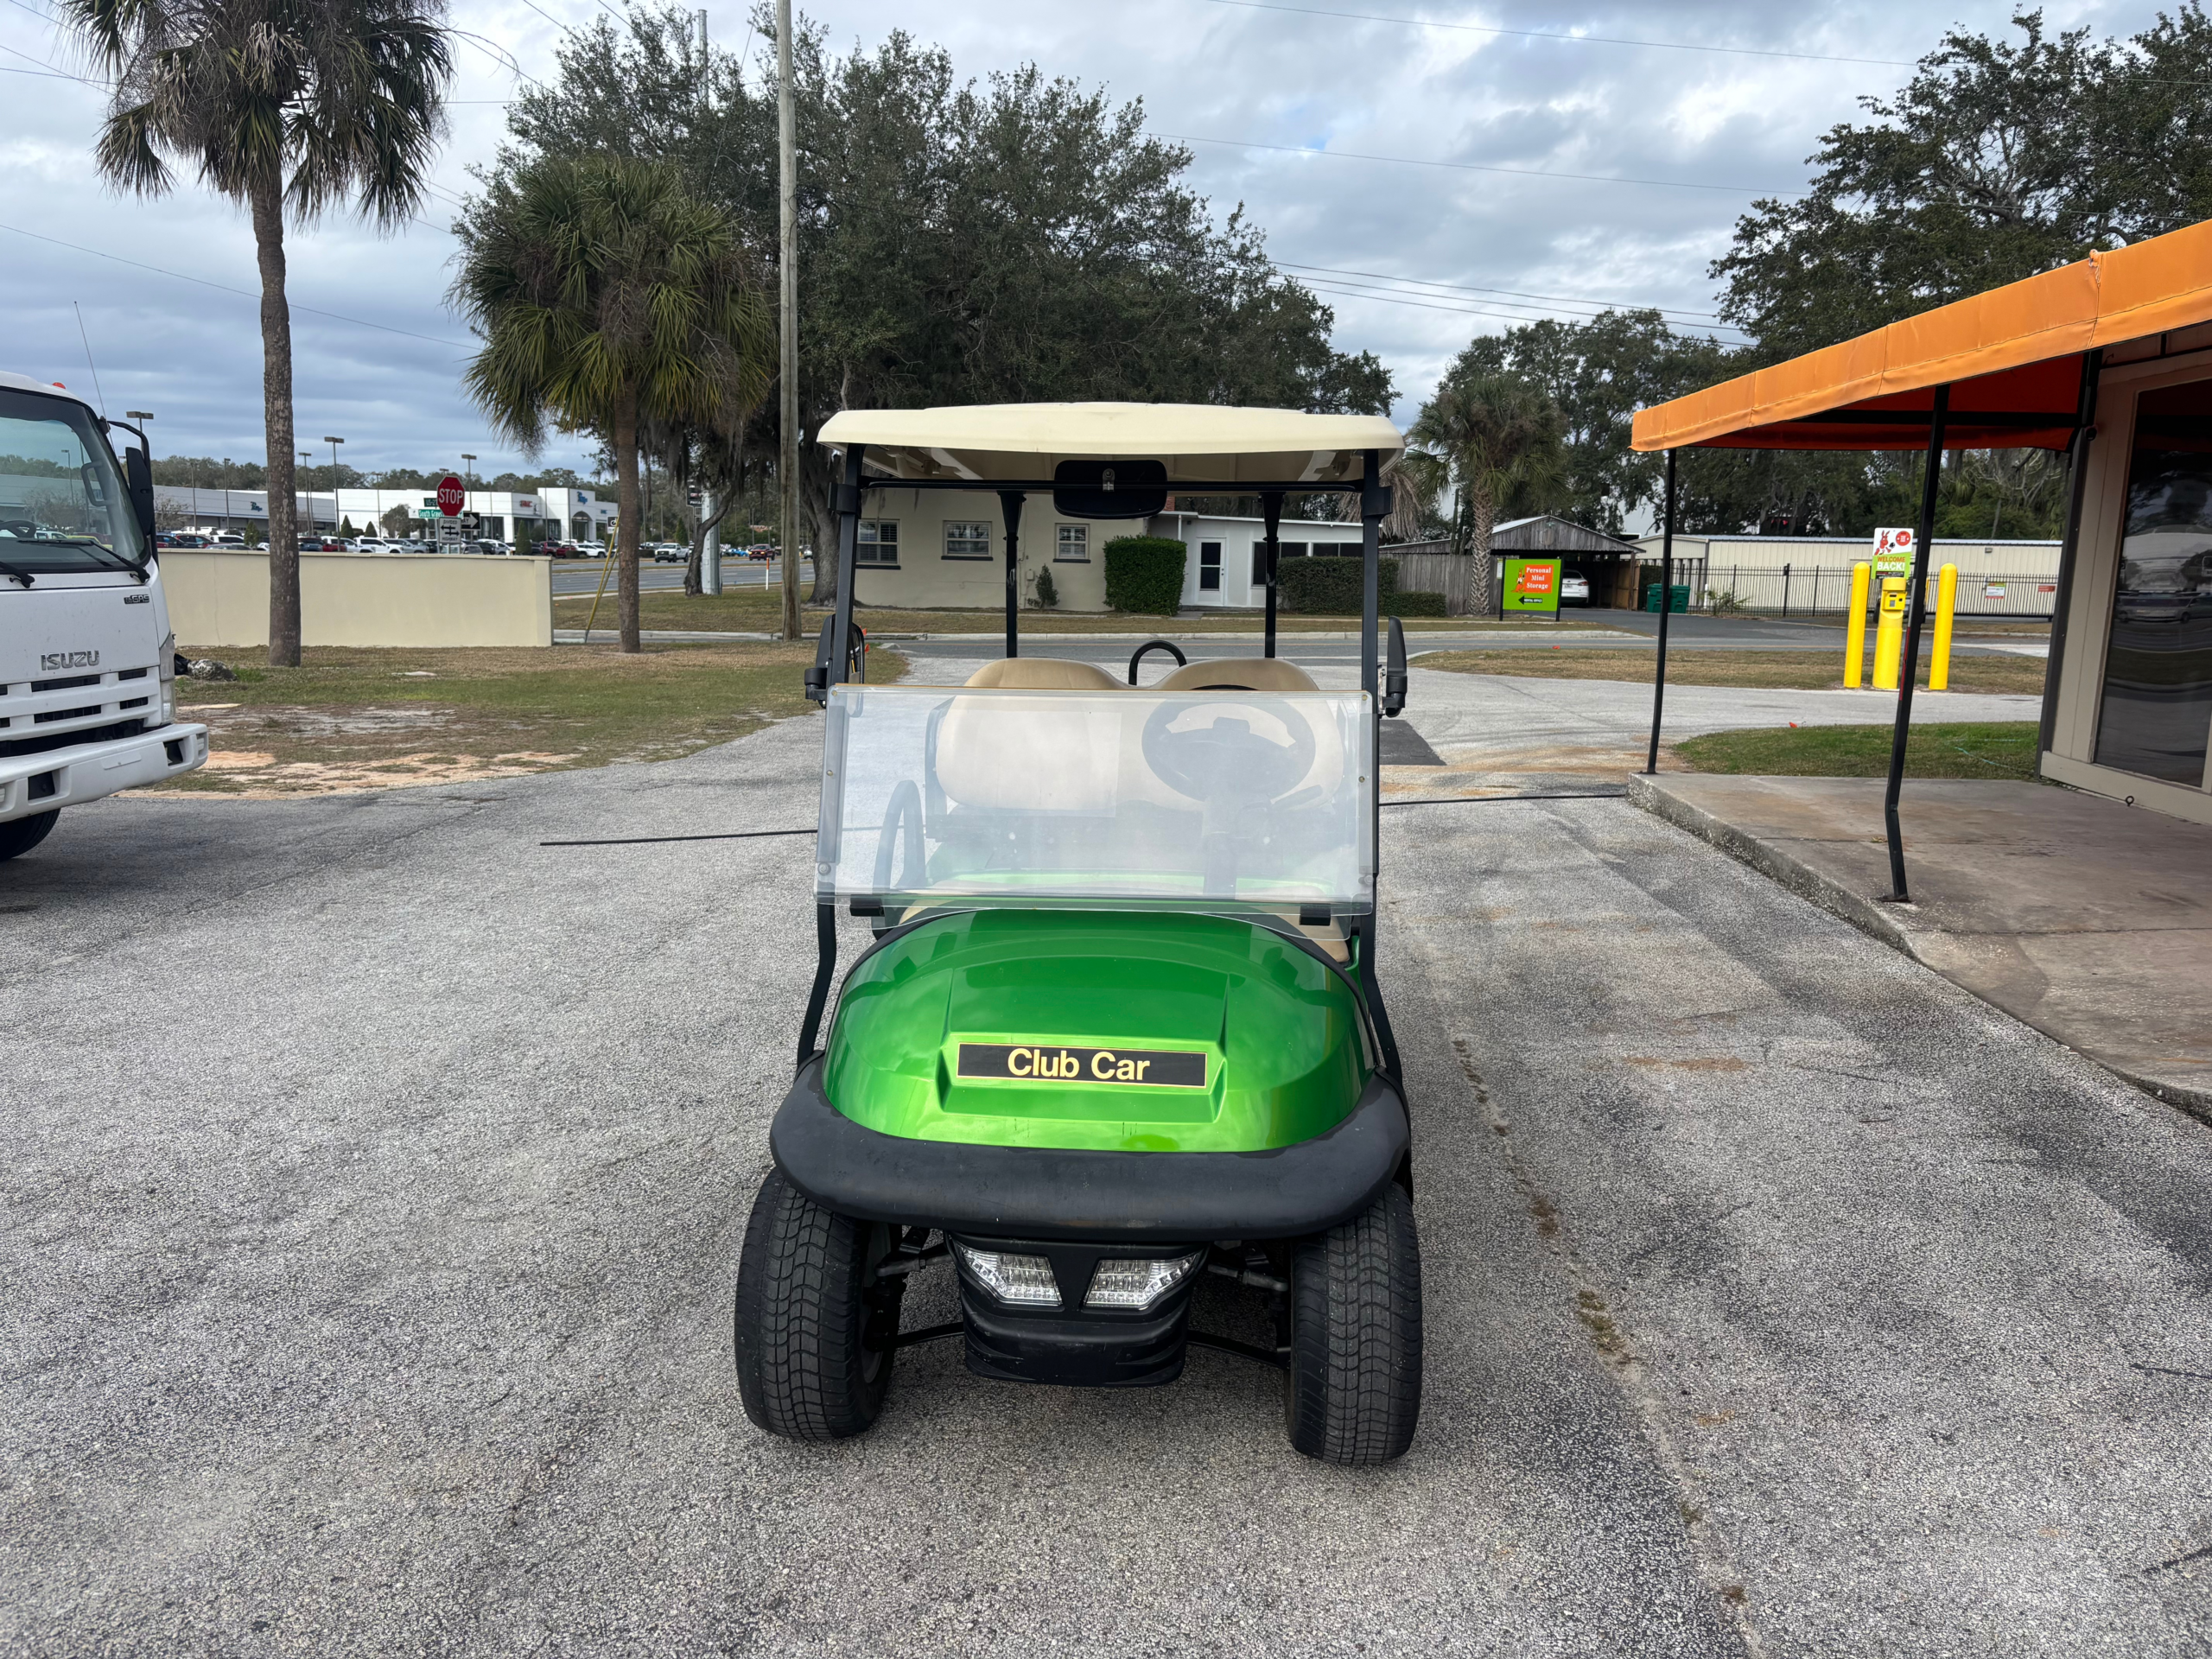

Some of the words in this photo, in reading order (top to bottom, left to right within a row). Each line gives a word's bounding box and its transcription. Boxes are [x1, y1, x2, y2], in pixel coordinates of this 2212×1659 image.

[438, 488, 463, 504] STOP
[419, 510, 430, 518] South
[41, 650, 99, 671] ISUZU
[1007, 1047, 1079, 1077] Club
[1090, 1051, 1150, 1080] Car
